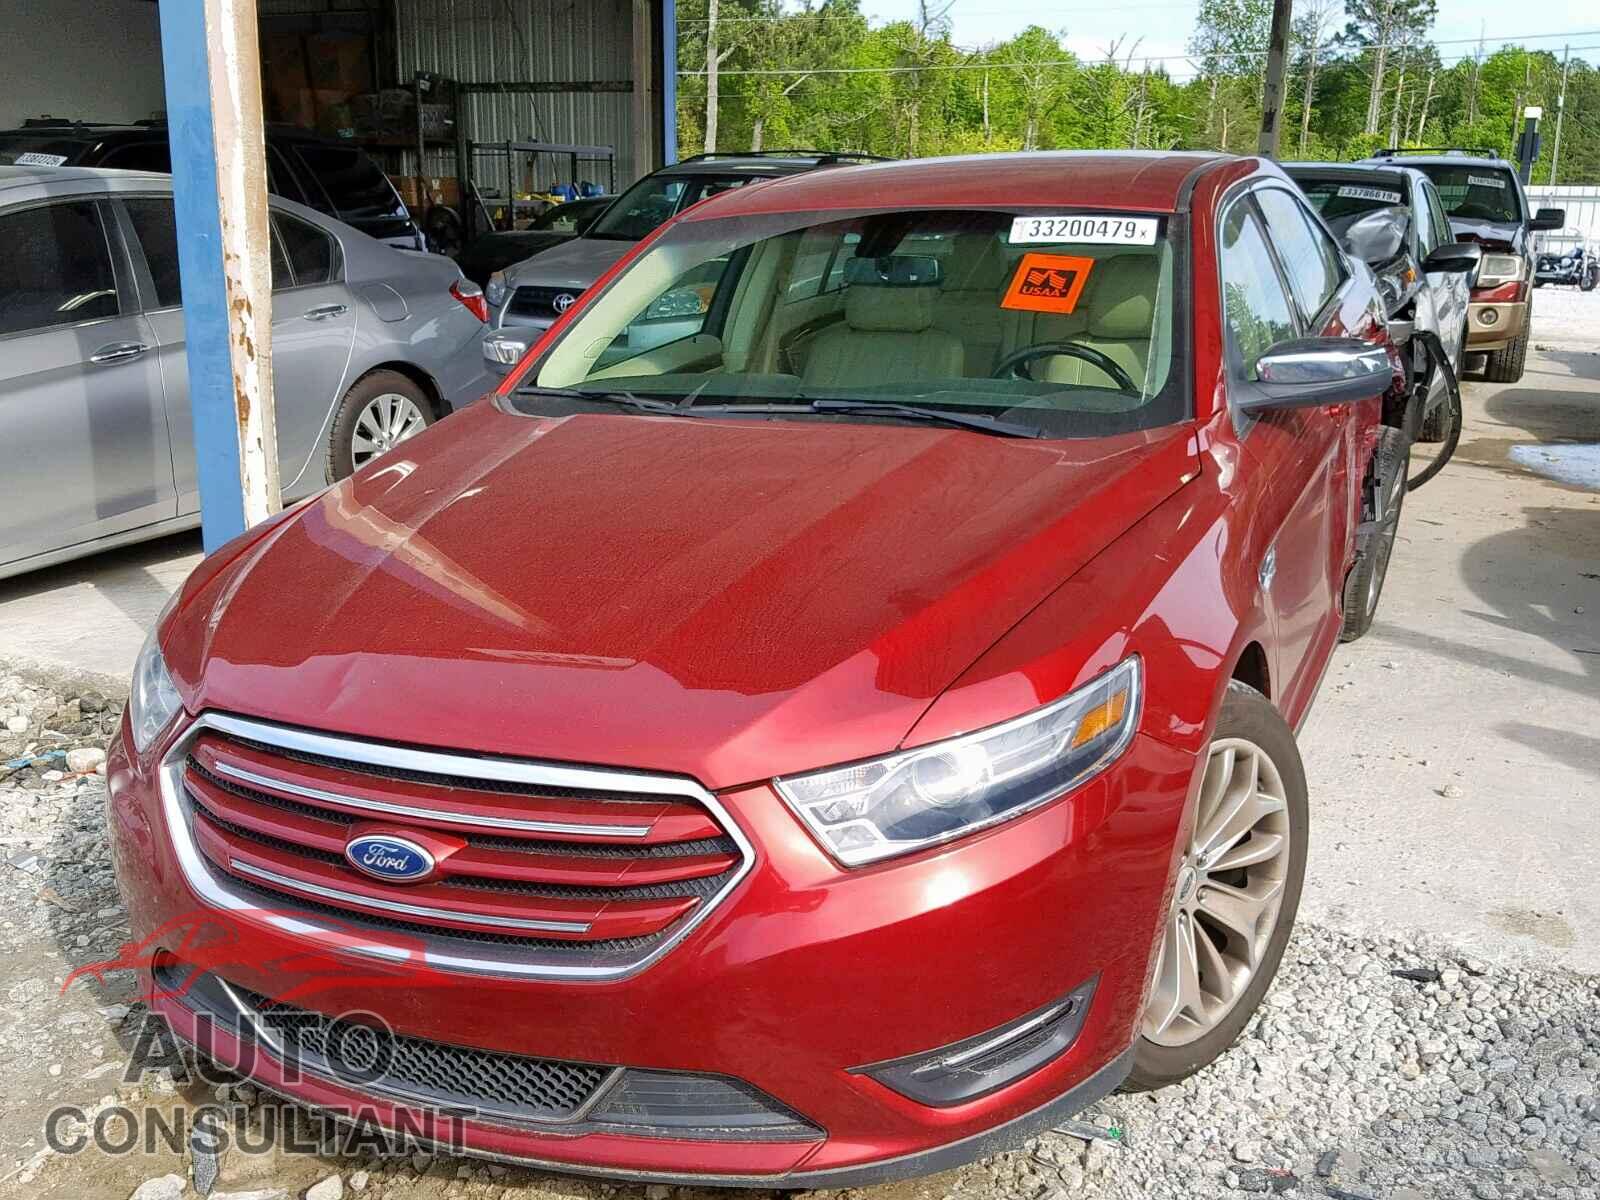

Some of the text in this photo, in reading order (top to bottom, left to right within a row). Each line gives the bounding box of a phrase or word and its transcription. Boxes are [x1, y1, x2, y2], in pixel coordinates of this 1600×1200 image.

[1028, 219, 1137, 239] 33200479
[1022, 286, 1060, 297] USAA
[363, 843, 410, 871] Ford
